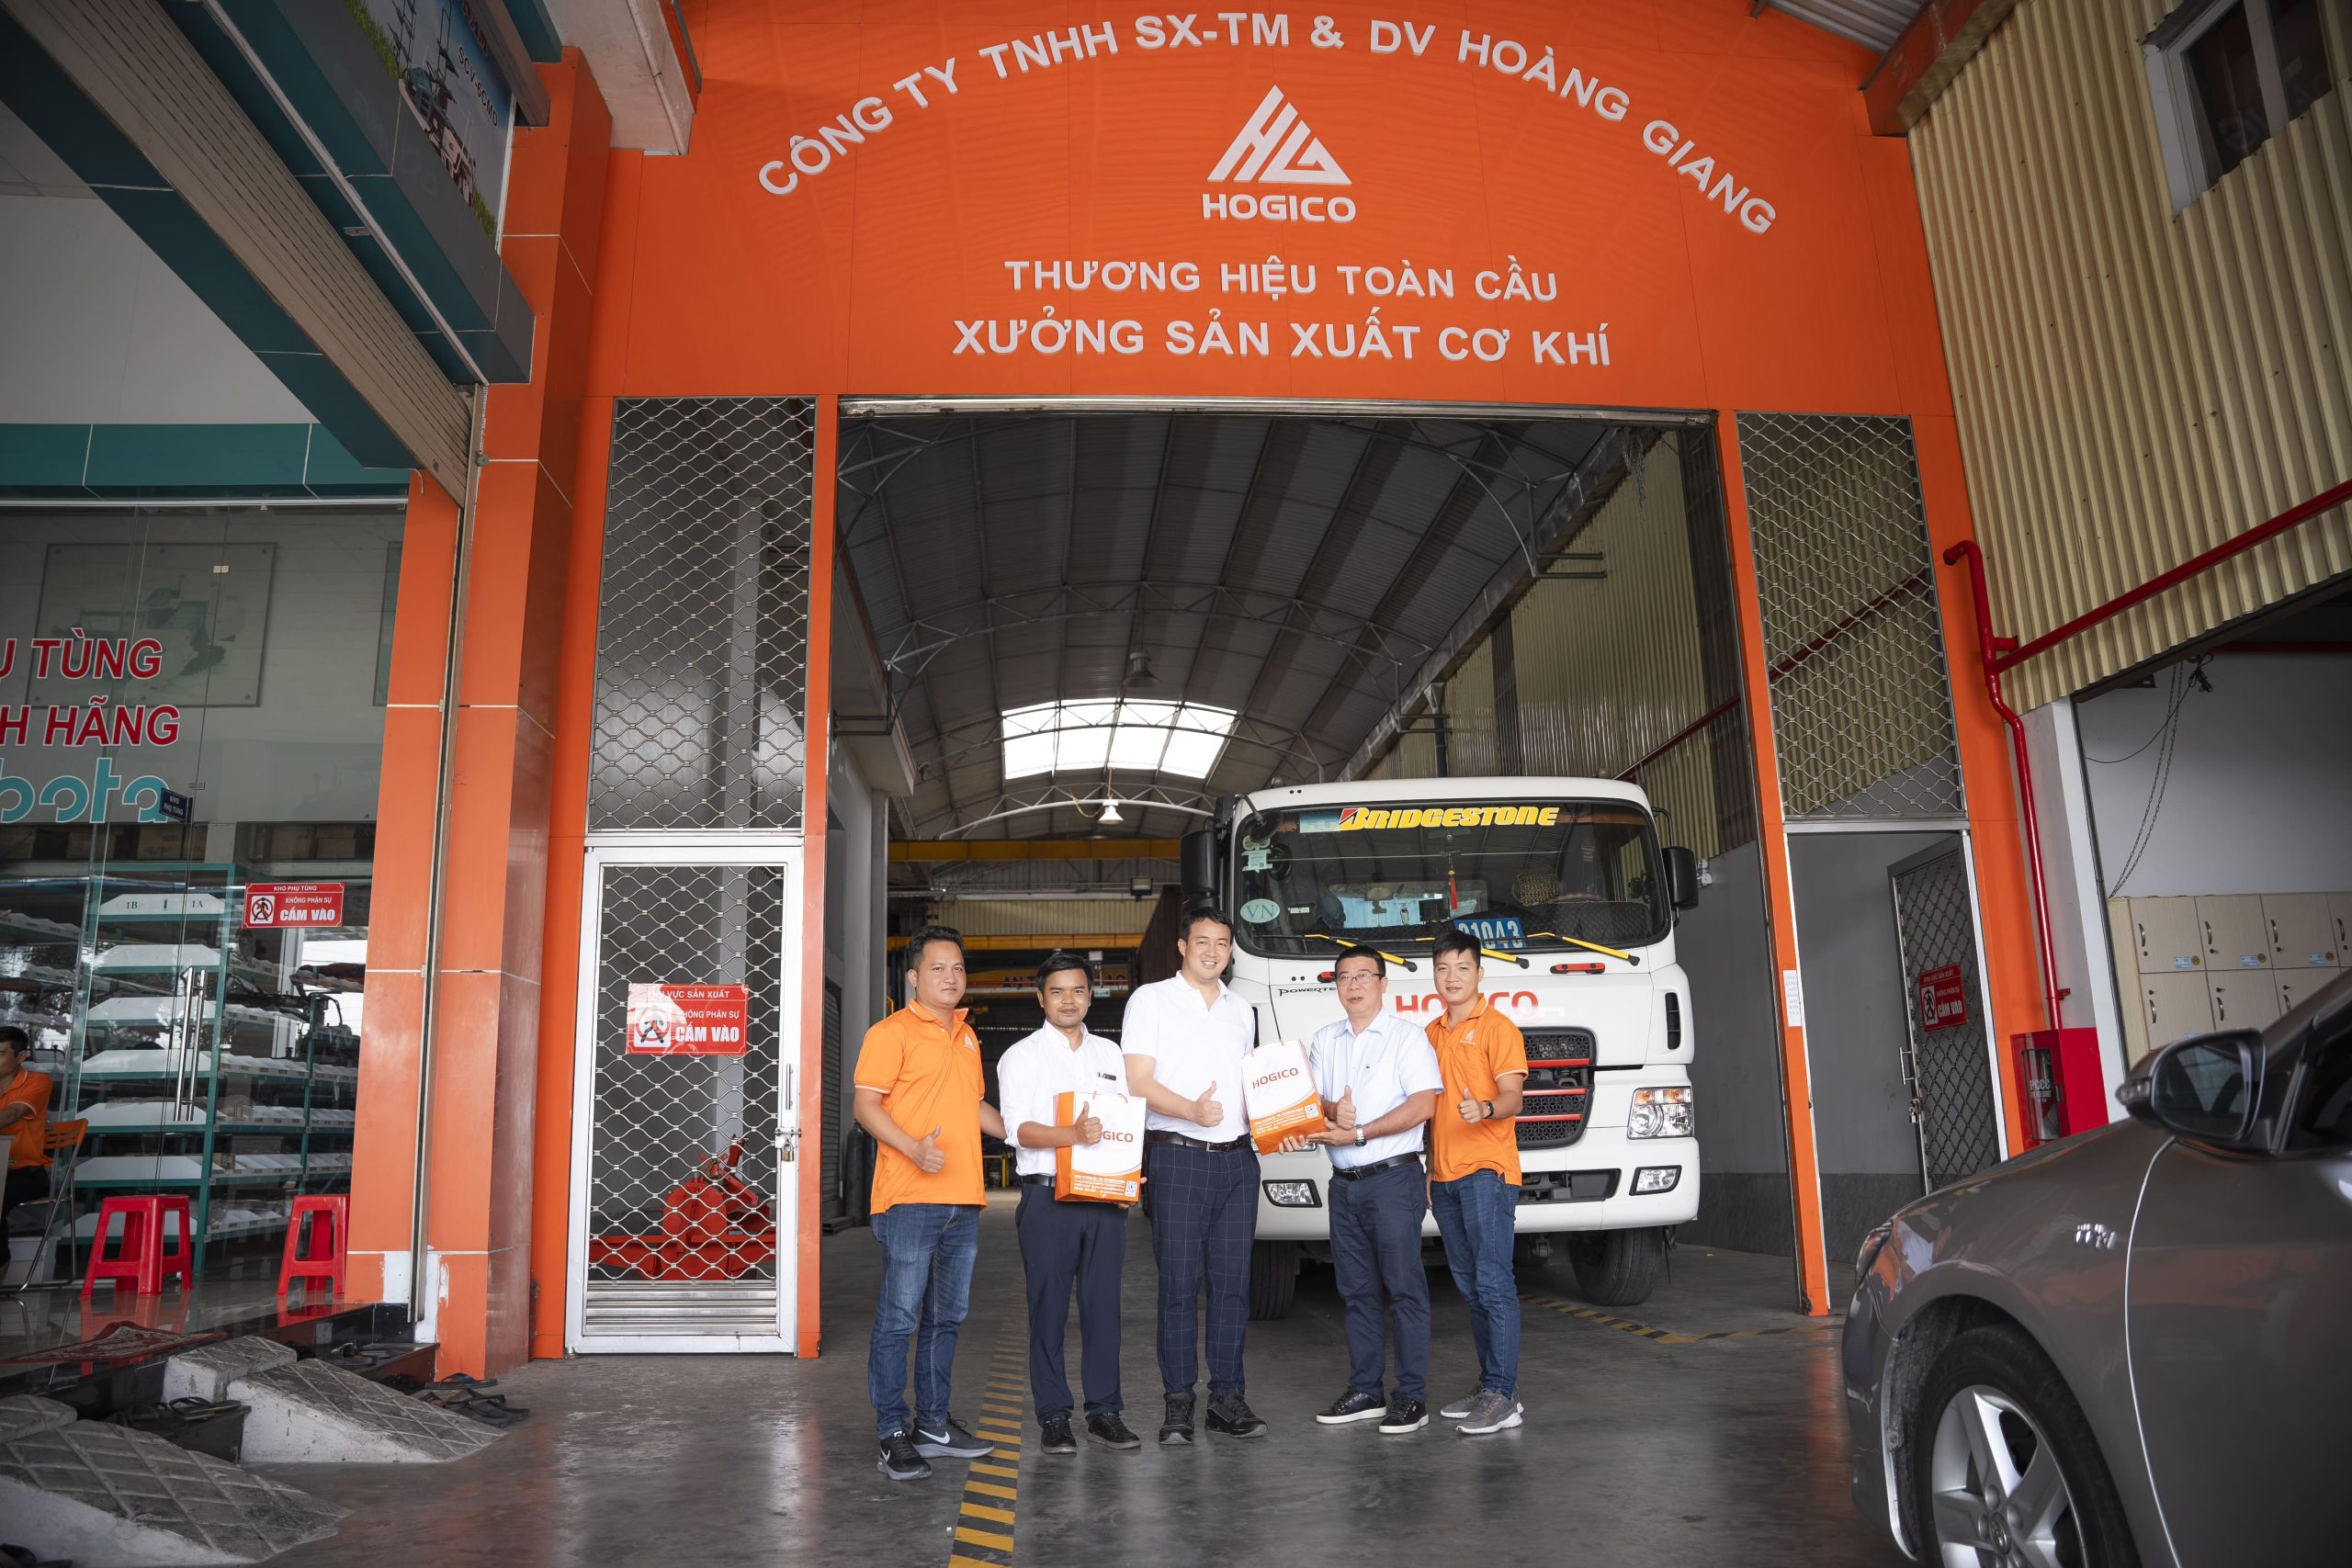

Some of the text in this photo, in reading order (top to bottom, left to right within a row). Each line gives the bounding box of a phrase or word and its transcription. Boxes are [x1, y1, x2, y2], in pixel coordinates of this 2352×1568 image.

[759, 13, 1776, 235] CÔNG TY TNHH SX-TM & DV HOÀNG GIANG
[1202, 194, 1356, 223] HOGICO
[1004, 254, 1557, 302] THƯƠNG HIỆU TOÀN CẦU
[953, 306, 1611, 367] XƯỞNG SẢN XUẤT CƠ KHÍ
[31, 627, 163, 680] TÙNG
[42, 694, 180, 747] HÃNG
[1337, 807, 1559, 831] BRIDGESTONE
[280, 906, 335, 921] CẤM VÀO
[1246, 905, 1274, 919] VN
[687, 988, 705, 998] SẢN
[707, 988, 729, 998] XUẤT
[682, 1009, 704, 1019] HÔNG
[675, 1021, 740, 1043] CẤM VÀO
[1251, 1067, 1299, 1089] HOGICO
